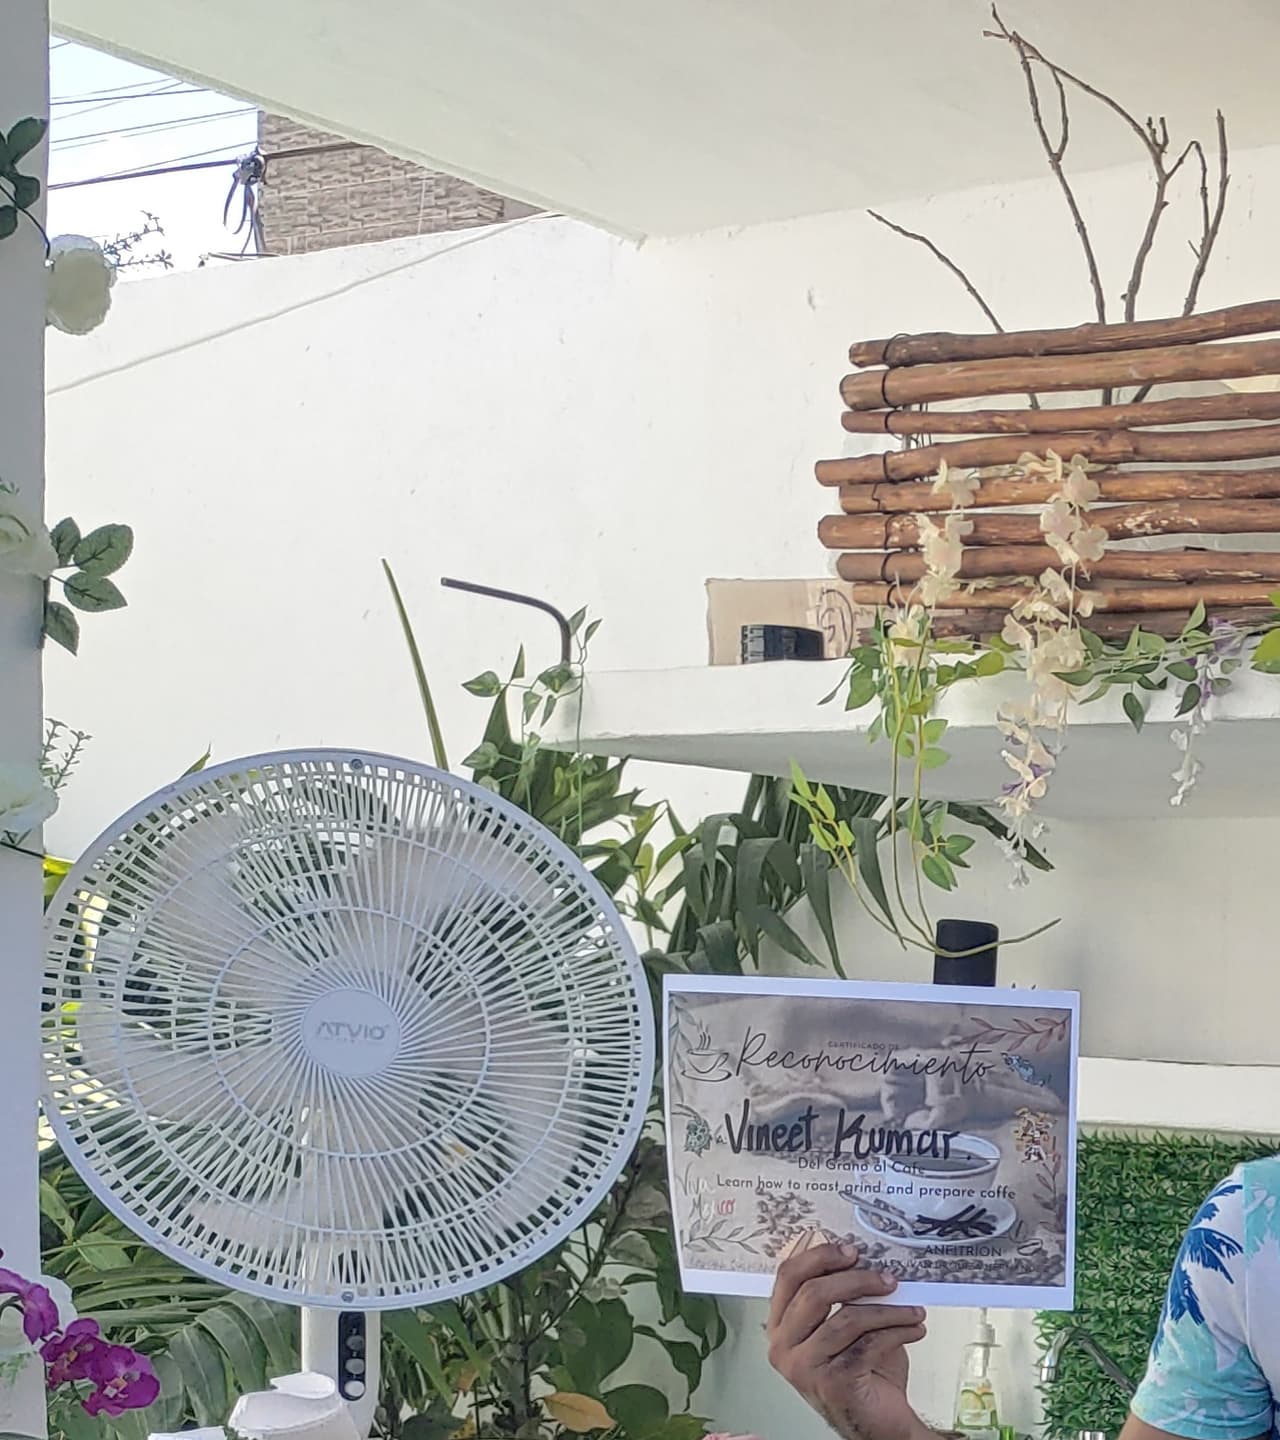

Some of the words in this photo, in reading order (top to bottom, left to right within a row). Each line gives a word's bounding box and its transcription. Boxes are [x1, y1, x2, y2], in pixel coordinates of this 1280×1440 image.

[317, 1021, 385, 1040] ATVIO
[735, 1026, 995, 1084] Reconocimiento
[725, 1098, 820, 1154] Vineet
[798, 1156, 820, 1171] Del
[826, 1157, 868, 1173] Grano
[873, 1160, 887, 1173] al
[717, 1174, 753, 1188] Learn
[757, 1175, 783, 1190] how
[788, 1177, 801, 1190] to
[844, 1180, 881, 1196] grind
[886, 1181, 914, 1195] and
[919, 1185, 976, 1199] prepare
[980, 1185, 1016, 1200] coffe
